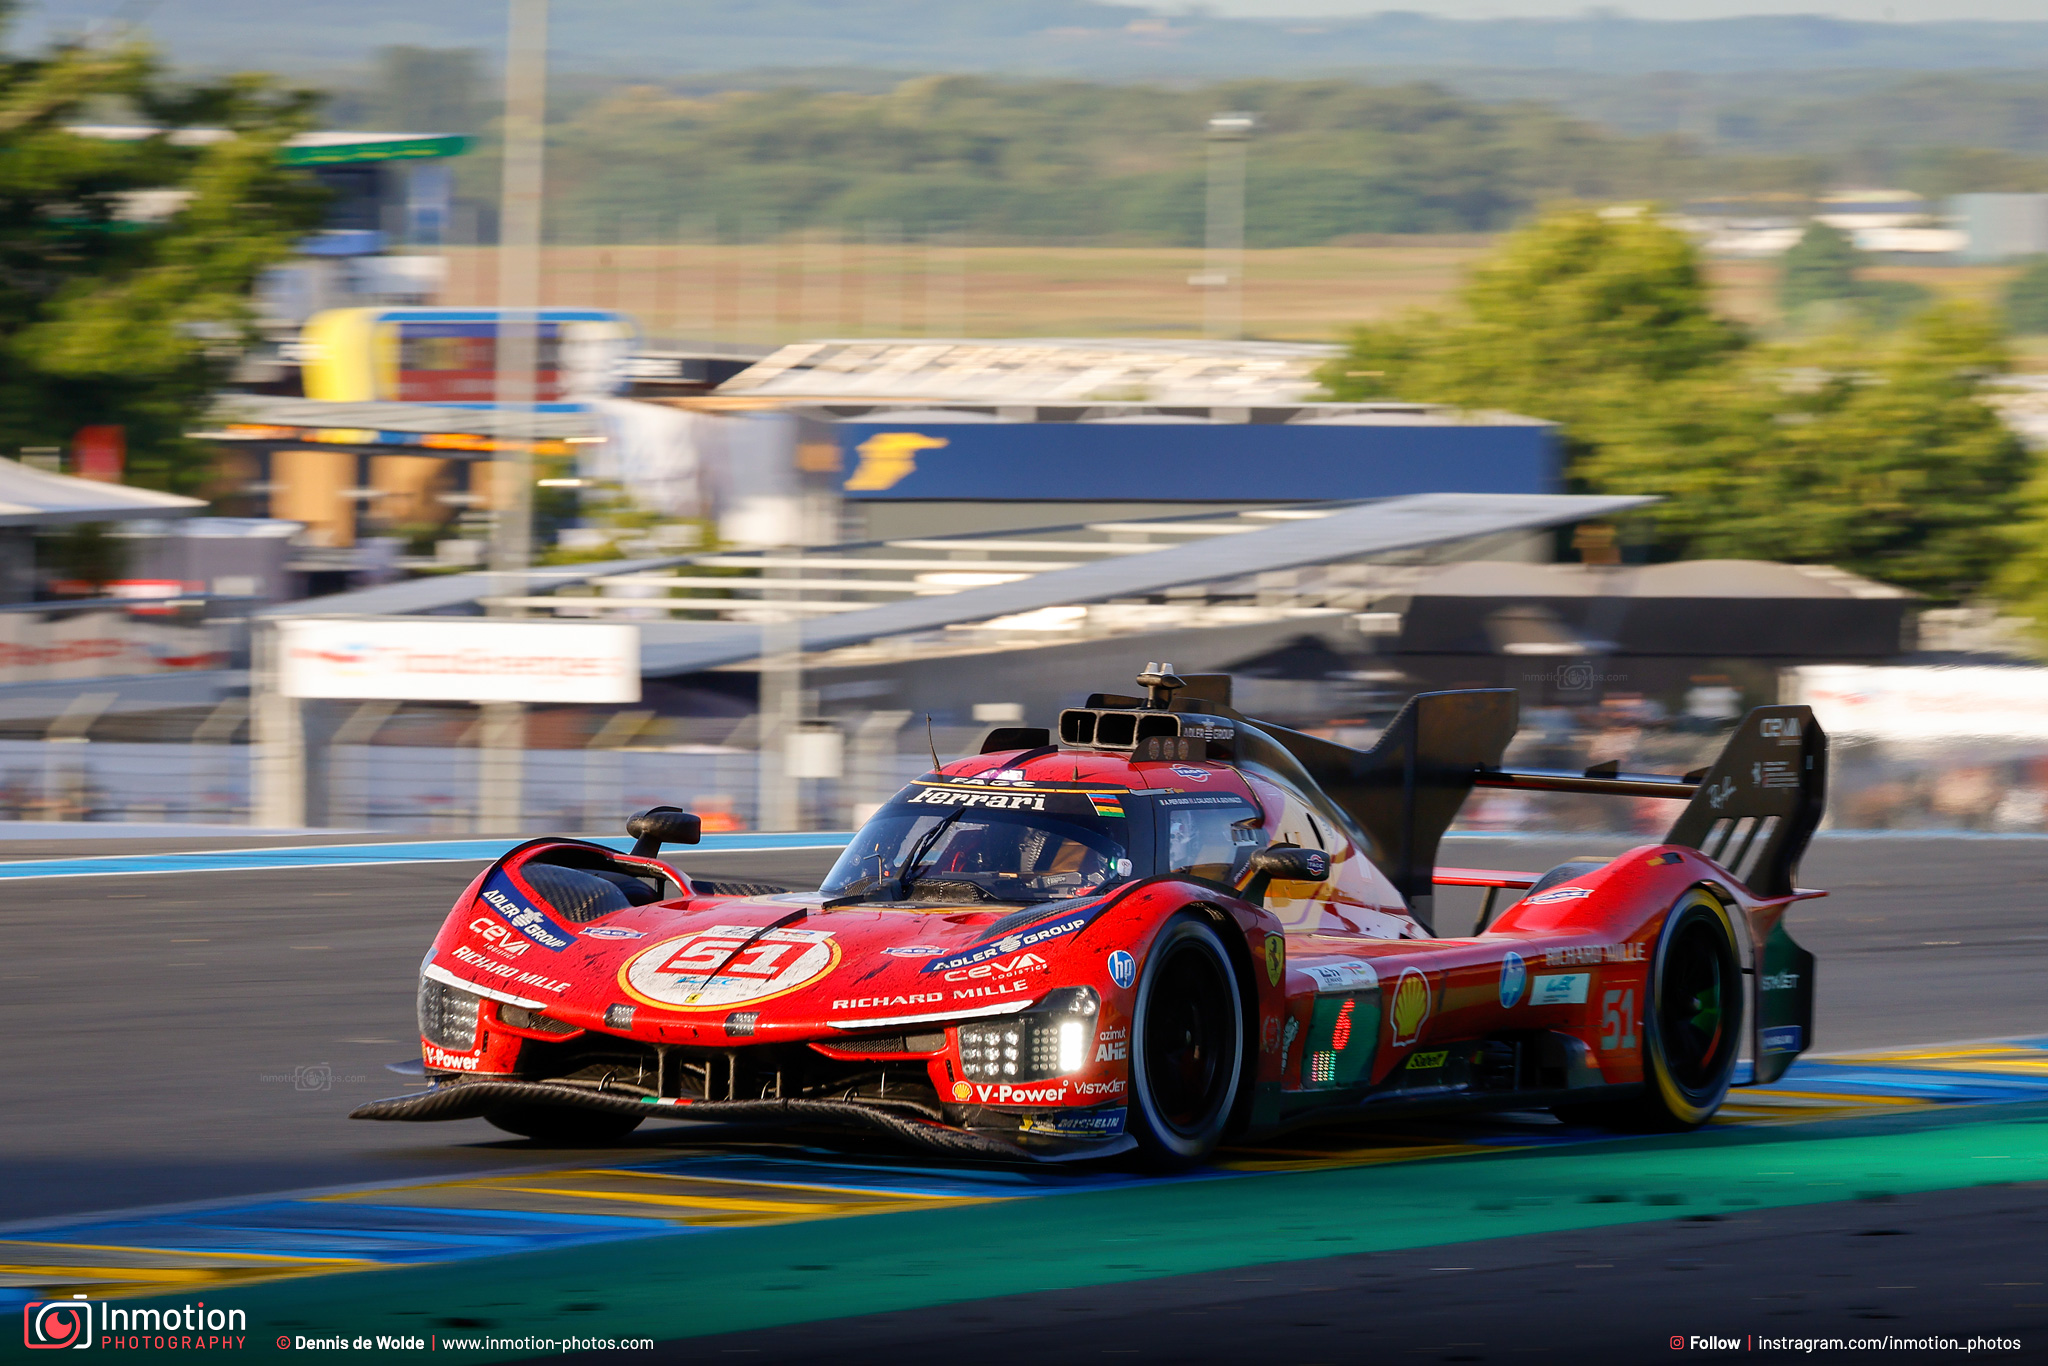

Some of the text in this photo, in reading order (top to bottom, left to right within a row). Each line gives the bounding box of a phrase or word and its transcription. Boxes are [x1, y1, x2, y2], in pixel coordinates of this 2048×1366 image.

[1184, 727, 1235, 740] ADLER GROUP
[907, 787, 1046, 811] Ferrari
[483, 889, 567, 948] ADLER GROUP
[667, 939, 793, 975] 51
[933, 918, 1085, 971] ADLER GROUP
[451, 945, 571, 993] RICHARD MILLE
[991, 964, 1048, 981] LOGISTICS
[1113, 951, 1132, 988] hp
[832, 979, 1028, 1009] RICHARD MILLE
[1100, 1026, 1126, 1041] azimut
[1601, 988, 1637, 1050] 51
[426, 1045, 480, 1070] V-Power
[976, 1083, 1067, 1103] V-Power
